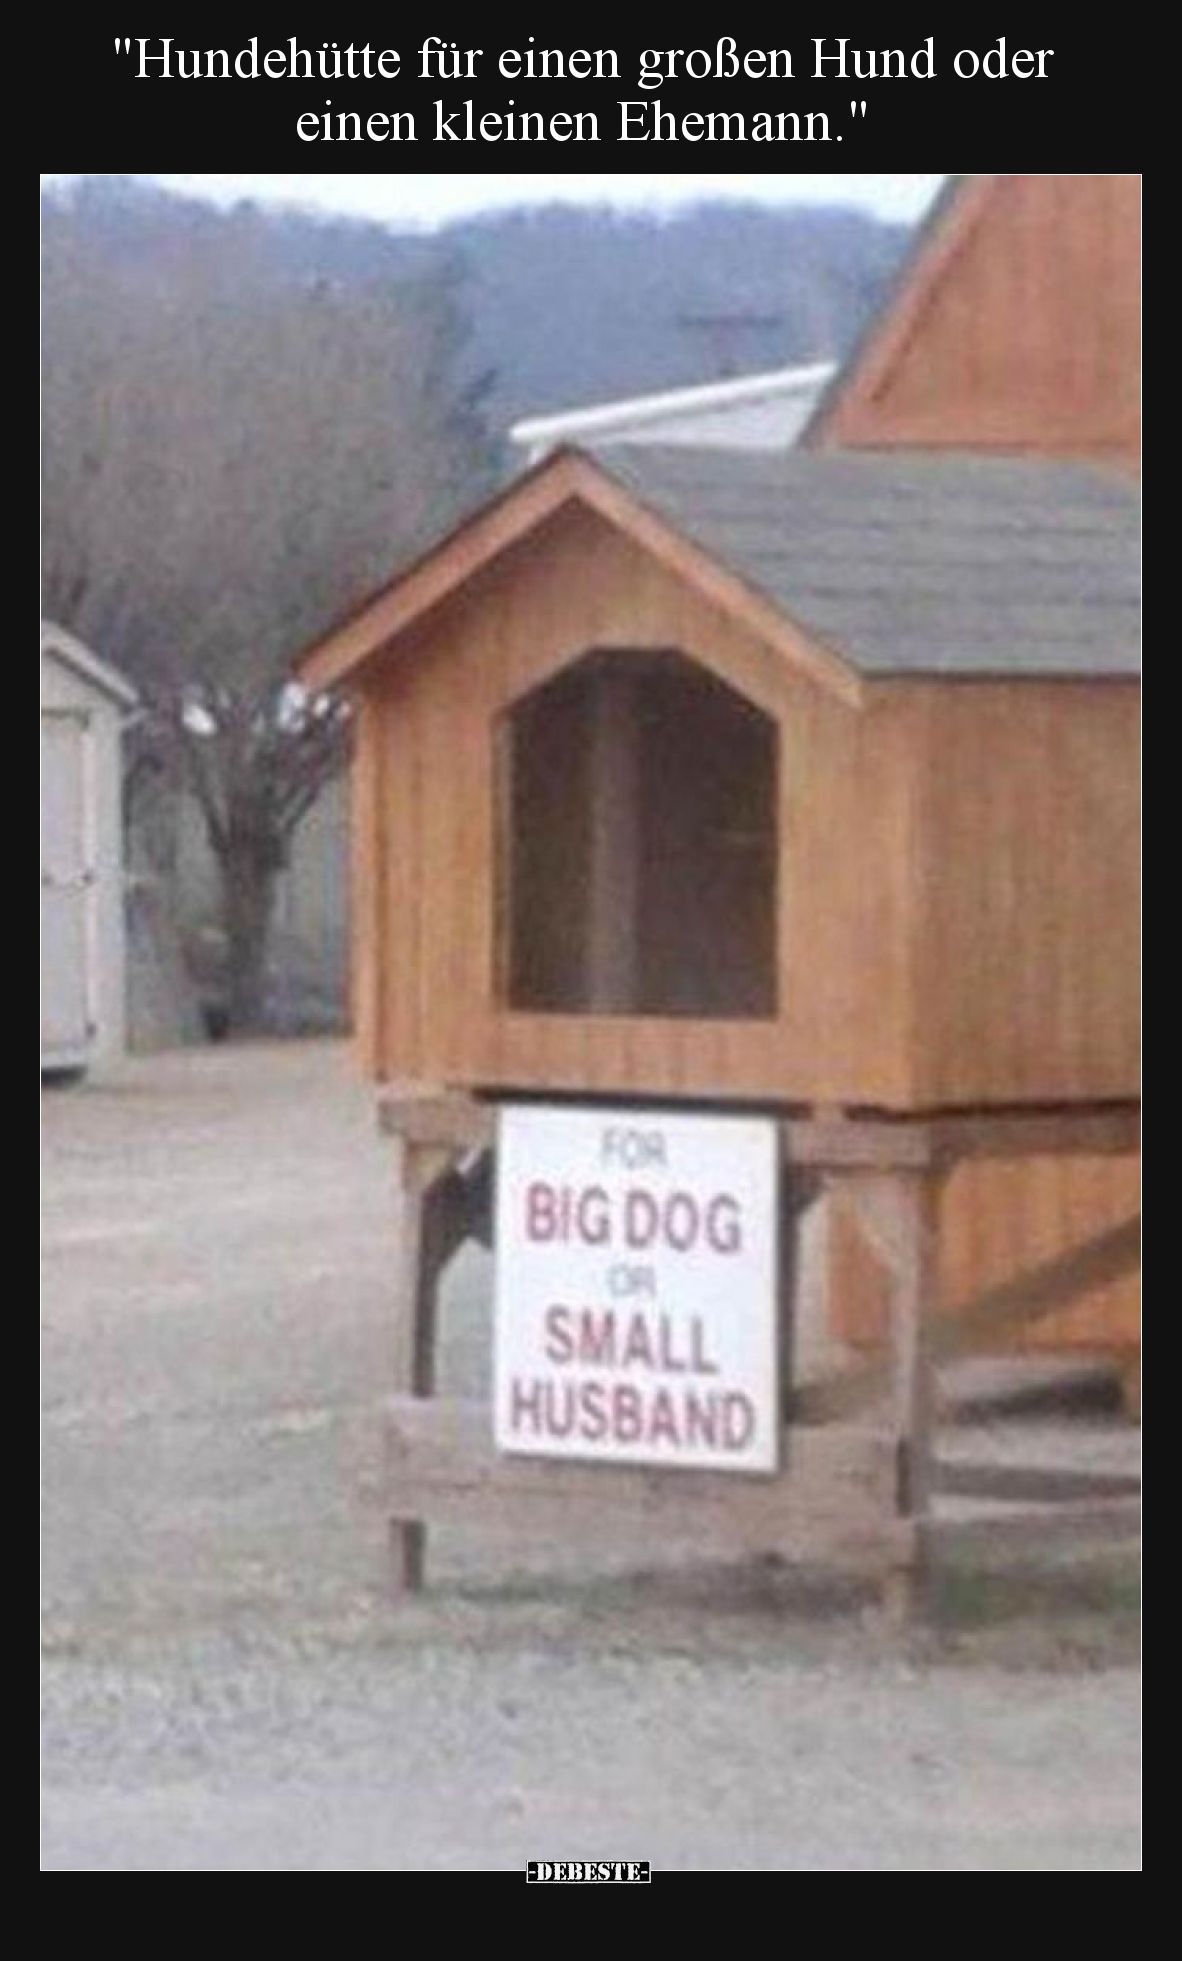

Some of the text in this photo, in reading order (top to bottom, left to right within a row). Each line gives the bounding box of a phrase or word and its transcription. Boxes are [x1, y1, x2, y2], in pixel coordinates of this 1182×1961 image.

[602, 1128, 668, 1169] FOR
[526, 1181, 742, 1254] BIG DOG
[607, 1263, 657, 1298] OR
[544, 1303, 720, 1375] SMALL
[511, 1376, 755, 1451] HUSBAND
